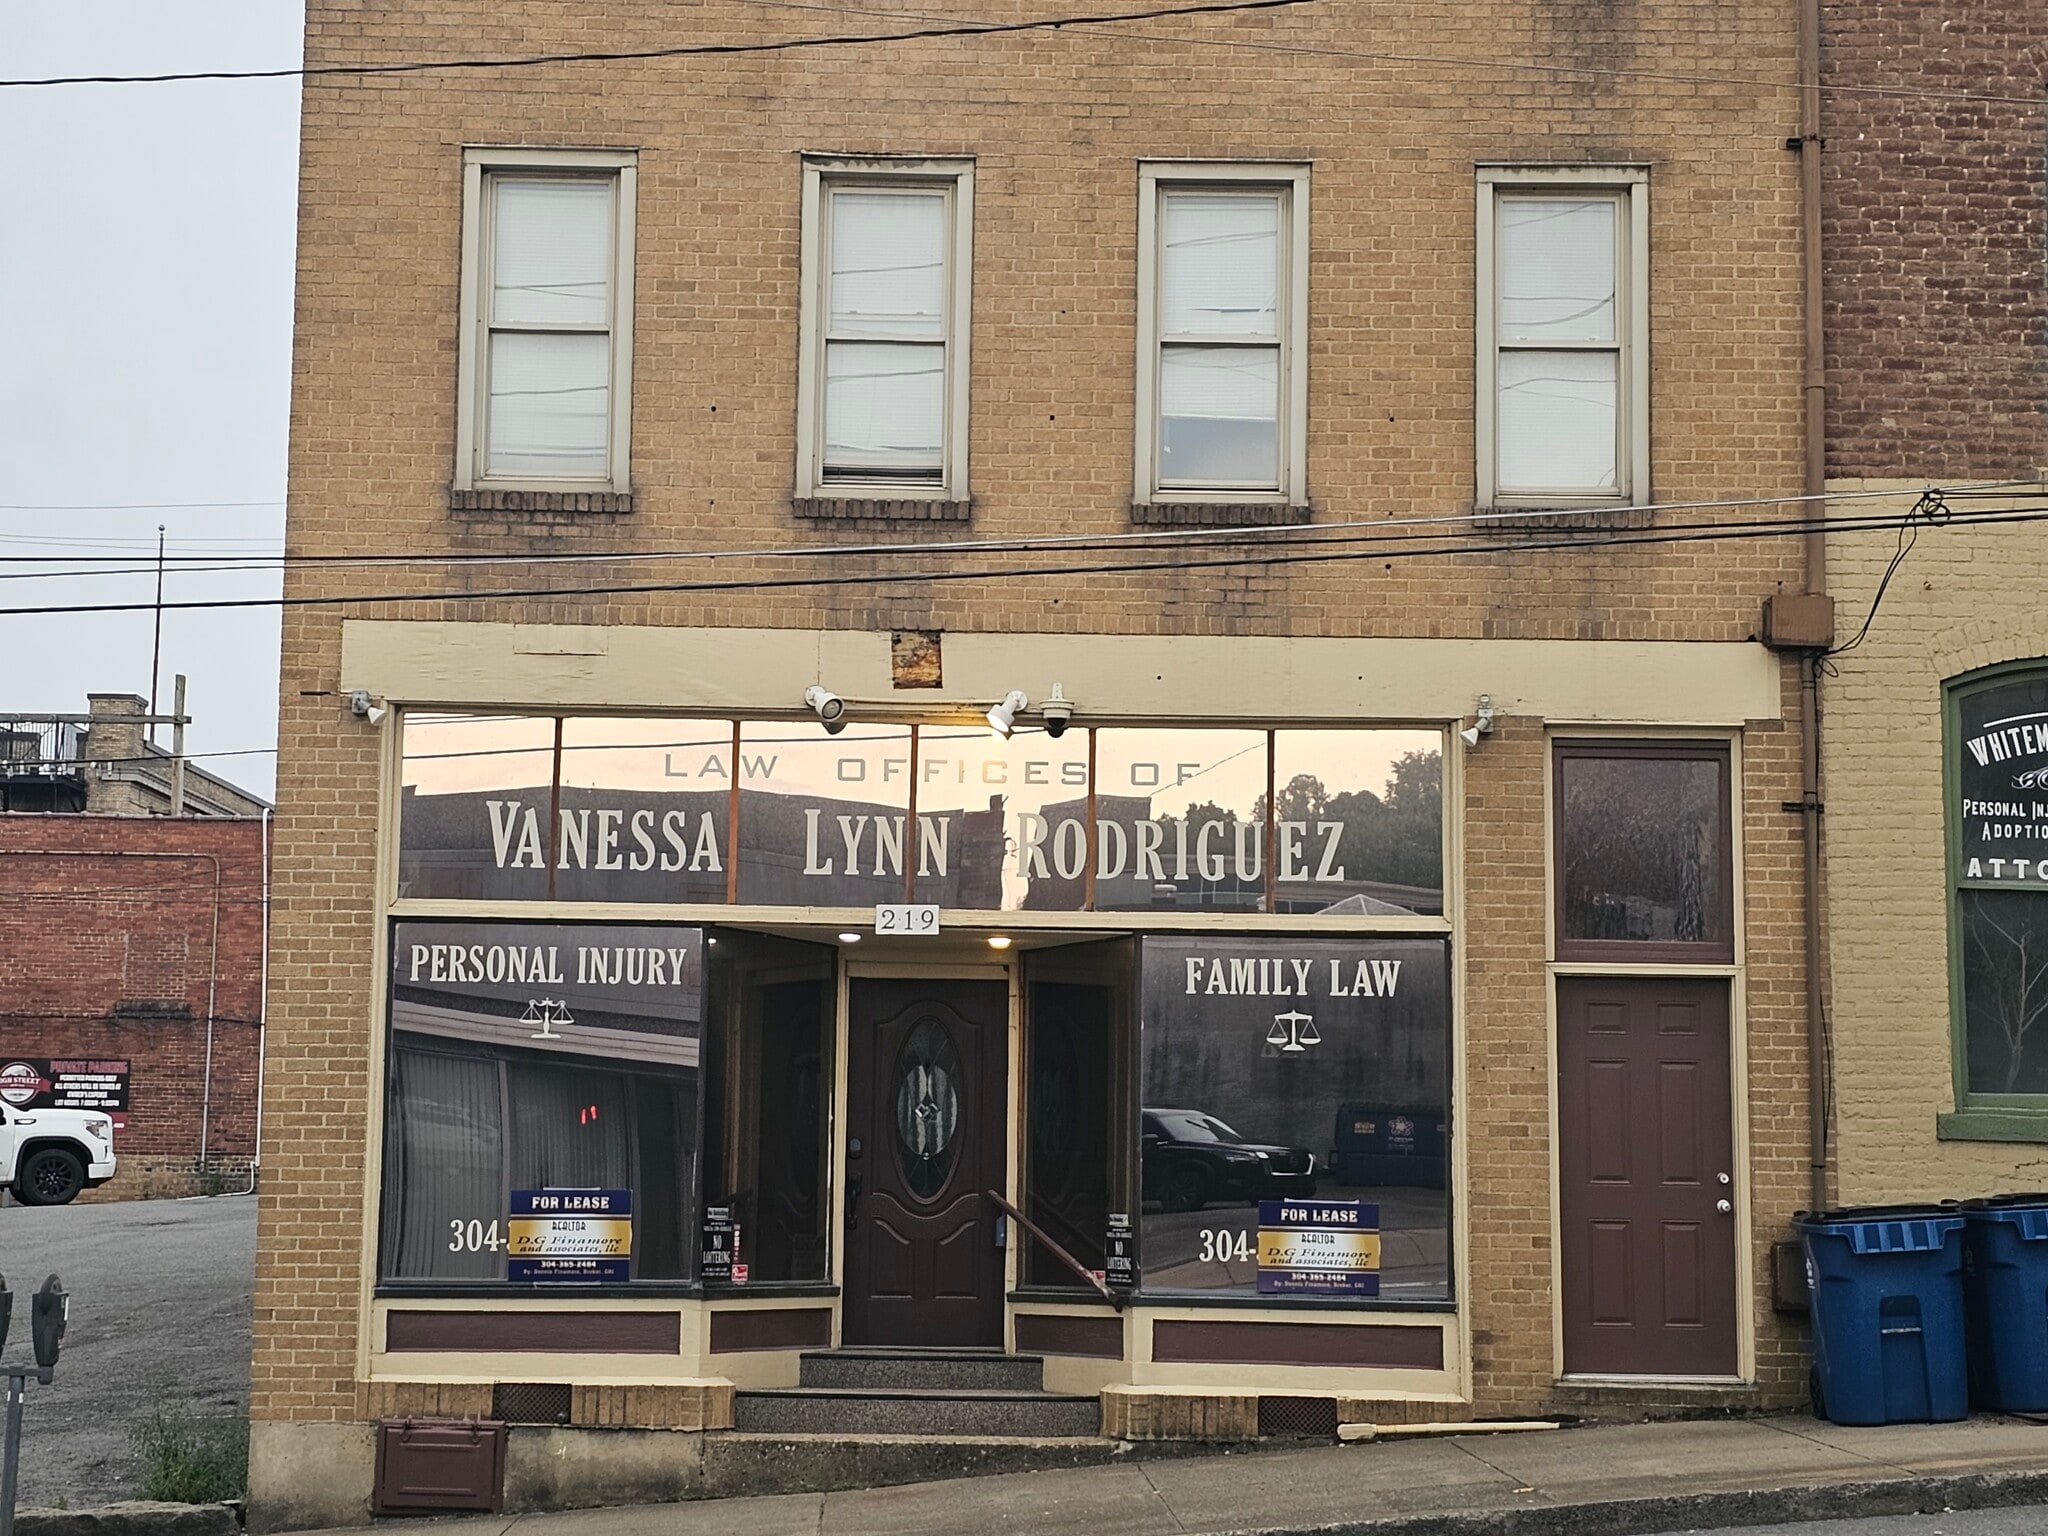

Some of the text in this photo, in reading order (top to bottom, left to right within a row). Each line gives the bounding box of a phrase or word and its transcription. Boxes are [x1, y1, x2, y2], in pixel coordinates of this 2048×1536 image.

[664, 753, 1201, 787] LAW OFFICES OF
[1963, 799, 2027, 818] PERSONAL
[486, 800, 1345, 883] VANESSA LYNN RODRIGUEZ
[880, 908, 935, 931] 219
[409, 944, 687, 986] PERSONAL INJURY
[1185, 957, 1402, 998] FAMILY LAW
[532, 1196, 610, 1209] FOR LEASE
[1280, 1208, 1358, 1223] FOR LEASE
[551, 1221, 586, 1231] REALTOR
[449, 1219, 510, 1252] 304-
[517, 1235, 623, 1245] D.G Finamore
[713, 1234, 723, 1250] NO
[1301, 1234, 1336, 1244] REALTOR
[520, 1244, 543, 1253] and
[1199, 1229, 1259, 1262] 304-
[1267, 1248, 1372, 1259] D.G Finamore
[1270, 1256, 1293, 1265] and
